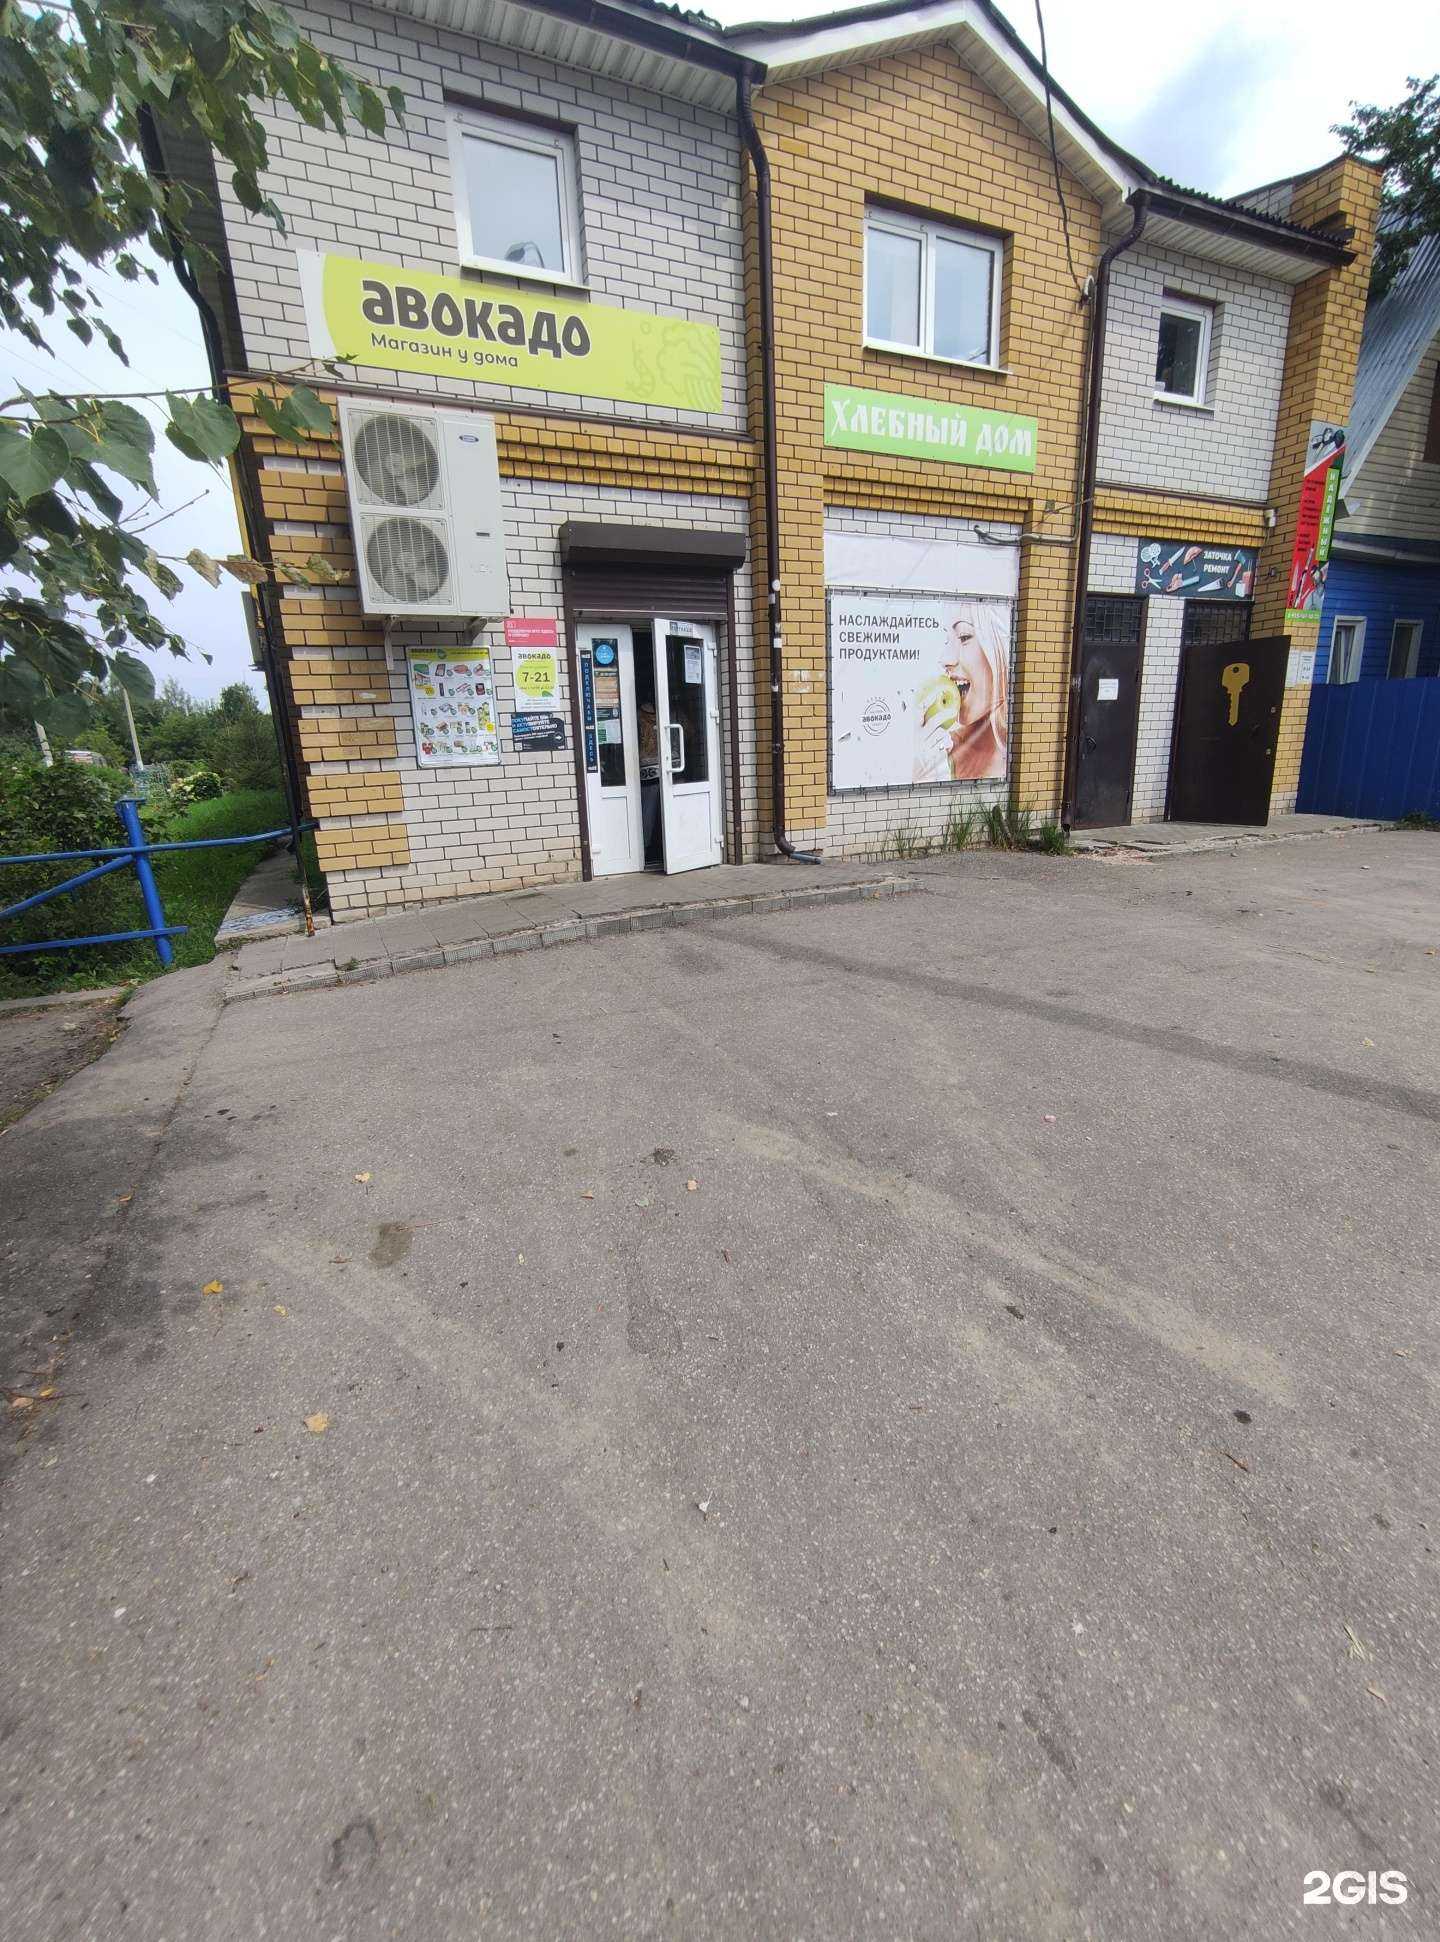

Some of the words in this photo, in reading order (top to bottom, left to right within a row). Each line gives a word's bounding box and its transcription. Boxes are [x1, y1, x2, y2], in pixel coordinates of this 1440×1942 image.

[362, 280, 591, 359] авокадо
[371, 333, 452, 358] Магазин
[458, 349, 468, 362] у
[473, 351, 518, 367] дома
[831, 399, 967, 448] ХЛЕБНЫЙ
[975, 423, 1032, 456] ДОМ
[1203, 550, 1232, 561] ЗАТОЧКА
[1203, 564, 1230, 574] РЕМОНТ
[839, 614, 940, 629] НАСЛАЖДАЙТЕСЬ
[839, 632, 900, 643] СВЕЖИМИ
[839, 648, 920, 661] ПРОДУКТАМИ!
[522, 671, 551, 683] 7-21
[862, 713, 892, 723] авокадо
